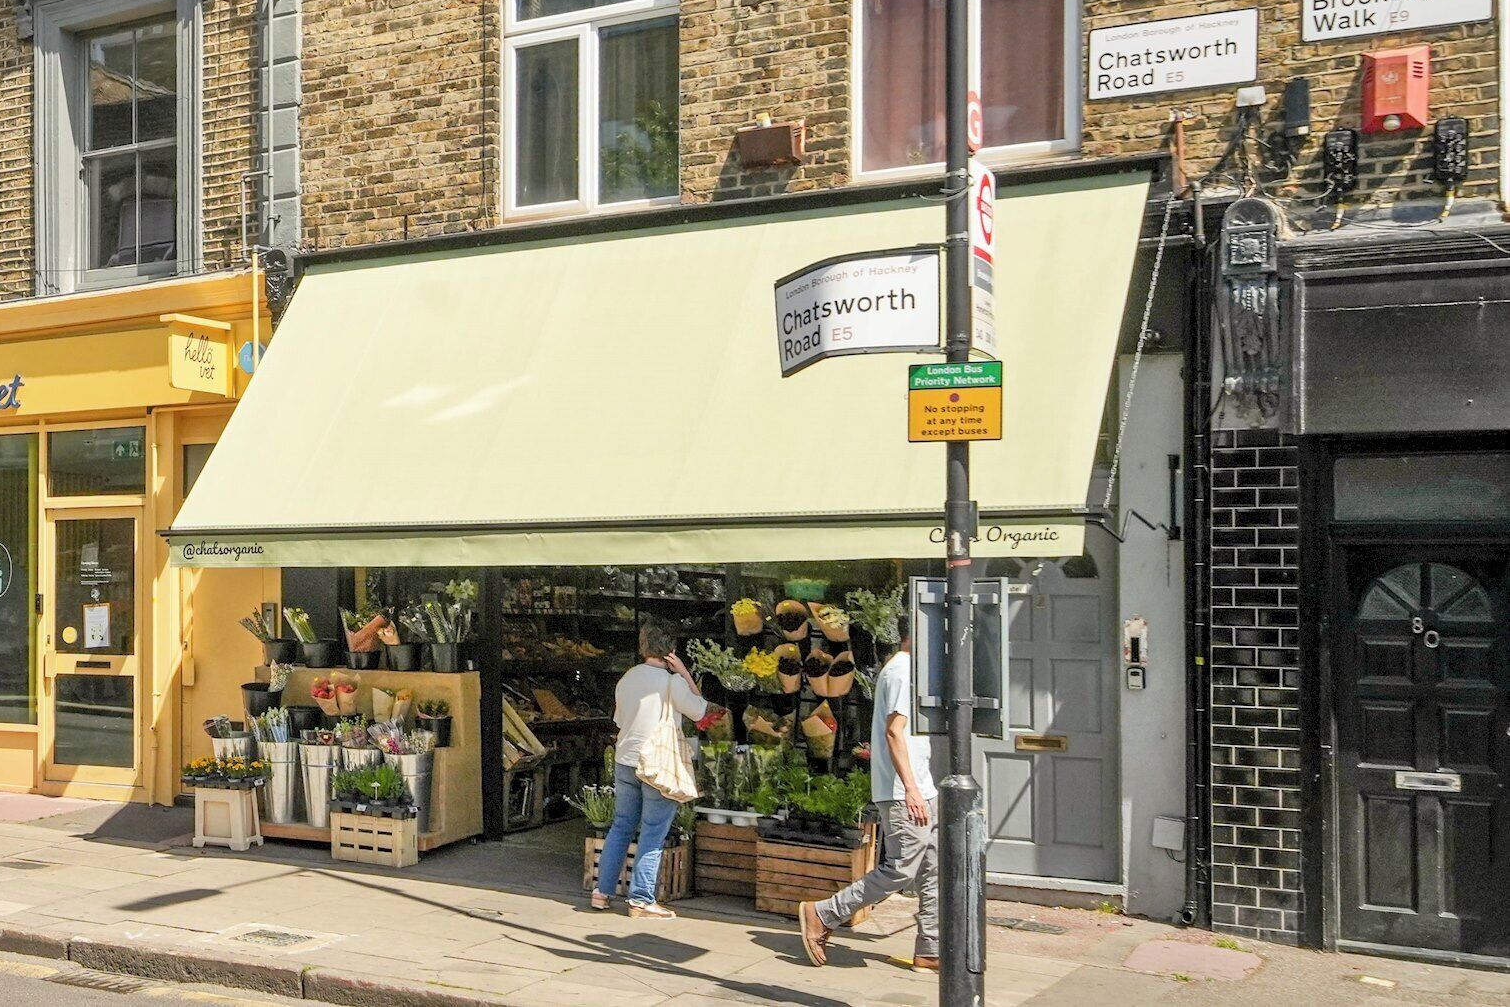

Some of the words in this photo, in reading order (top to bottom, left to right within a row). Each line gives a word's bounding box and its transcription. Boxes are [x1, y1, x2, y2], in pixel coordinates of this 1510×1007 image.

[1105, 32, 1140, 42] London
[1142, 27, 1182, 37] Borough
[1185, 24, 1195, 32] of
[1198, 19, 1240, 30] Hackney
[1313, 9, 1377, 33] Walk
[1389, 10, 1410, 25] E9
[1098, 38, 1238, 71] Chatsworth
[1097, 68, 1155, 92] Road
[1166, 71, 1185, 83] E5
[785, 284, 810, 300] London
[811, 271, 848, 289] Borough
[853, 267, 864, 278] of
[869, 264, 918, 277] Hackney
[782, 288, 916, 335] Chatsworth
[784, 324, 822, 361] Road
[831, 326, 853, 341] E5
[199, 365, 215, 380] vet
[914, 377, 950, 387] Priority
[953, 374, 996, 385] Network
[927, 367, 962, 375] London
[964, 365, 983, 373] Bus
[924, 405, 938, 413] No
[941, 404, 985, 414] stopping
[940, 417, 956, 425] any
[960, 416, 982, 424] time
[921, 428, 955, 437] except
[958, 427, 988, 435] buses
[987, 526, 1059, 549] Organic
[183, 540, 264, 561] @chatsorganic
